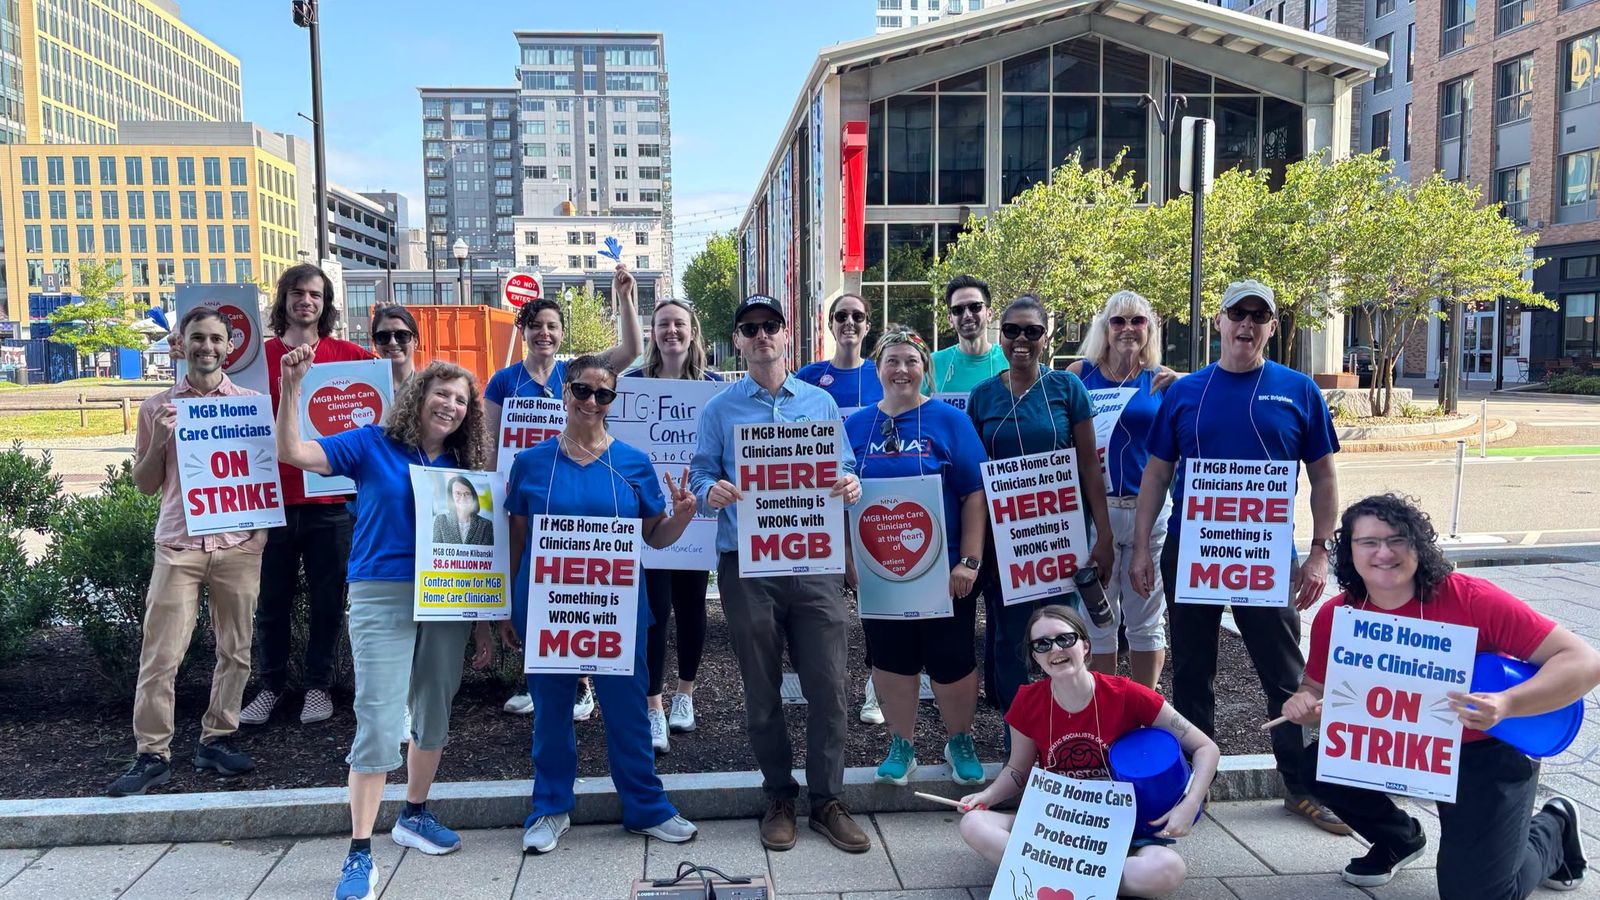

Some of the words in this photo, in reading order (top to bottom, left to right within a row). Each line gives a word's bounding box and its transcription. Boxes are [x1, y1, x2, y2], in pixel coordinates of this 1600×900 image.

[524, 281, 536, 289] NOT
[313, 395, 332, 404] MGB
[334, 393, 356, 401] Home
[327, 401, 363, 411] Clinicians
[508, 400, 514, 409] If
[516, 400, 535, 409] MGB
[536, 399, 561, 411] Home
[189, 404, 218, 419] MGB
[220, 404, 257, 417] Home
[352, 410, 373, 419] heart
[658, 395, 697, 421] Fair
[343, 421, 352, 429] of
[507, 412, 547, 424] Clinicians
[549, 415, 563, 425] Are
[179, 428, 209, 441] Care
[211, 424, 271, 440] Clinicians
[741, 428, 749, 441] If
[751, 426, 775, 440] MGB
[777, 426, 809, 439] Home
[811, 424, 834, 437] Care
[742, 444, 793, 459] Clinicians
[795, 443, 813, 456] Are
[815, 442, 834, 455] Out
[210, 449, 250, 479] ON
[987, 463, 995, 476] If
[997, 459, 1019, 476] MGB
[1020, 456, 1049, 471] Home
[1050, 453, 1071, 465] Care
[1192, 461, 1201, 474] If
[1203, 462, 1227, 474] MGB
[1229, 462, 1261, 475] Home
[1264, 463, 1289, 476] Care
[740, 461, 838, 491] HERE
[991, 476, 1037, 493] Clinicians
[1039, 474, 1055, 485] Are
[1056, 469, 1073, 482] Out
[1192, 478, 1243, 491] Clinicians
[1245, 480, 1265, 491] Are
[1267, 480, 1287, 492] Out
[187, 482, 279, 516] STRIKE
[756, 495, 814, 510] Something
[816, 495, 825, 507] is
[992, 486, 1079, 524] HERE
[863, 514, 881, 522] MGB
[882, 513, 905, 521] Home
[906, 511, 924, 519] Care
[1186, 496, 1289, 523] HERE
[540, 518, 549, 531] If
[550, 518, 574, 532] MGB
[577, 519, 609, 533] Home
[611, 520, 635, 534] Care
[757, 515, 798, 528] WRONG
[800, 513, 825, 527] with
[876, 522, 912, 531] Clinicians
[887, 534, 900, 542] the
[901, 531, 922, 540] heart
[1010, 521, 1060, 540] Something
[1062, 519, 1070, 531] is
[1200, 527, 1260, 542] Something
[1263, 529, 1272, 541] is
[432, 548, 444, 557] MGB
[445, 548, 455, 557] CEO
[456, 549, 469, 557] Anne
[539, 537, 591, 551] Clinicians
[593, 539, 611, 551] Are
[614, 540, 634, 552] Out
[751, 532, 832, 562] MGB
[892, 543, 901, 551] of
[1013, 541, 1048, 558] WRONG
[1050, 537, 1070, 551] with
[1200, 545, 1242, 558] WRONG
[1244, 547, 1270, 559] with
[433, 559, 449, 570] $8.6
[450, 560, 478, 570] MILLION
[479, 561, 492, 570] PAY
[882, 558, 905, 567] patient
[534, 556, 635, 586] HERE
[1009, 553, 1079, 589] MGB
[1189, 562, 1275, 591] MGB
[424, 576, 453, 587] Contract
[456, 579, 471, 588] now
[473, 578, 483, 588] for
[485, 578, 501, 588] MGB
[423, 592, 444, 602] Home
[446, 592, 462, 603] Care
[464, 592, 502, 603] Clinicians!
[548, 591, 608, 607] Something
[610, 593, 619, 605] is
[549, 610, 590, 624] WRONG
[592, 612, 617, 625] with
[538, 629, 622, 658] MGB
[1353, 619, 1393, 642] MGB
[1397, 626, 1452, 653] Home
[1333, 646, 1373, 669] Care
[1377, 653, 1466, 684] Clinicians
[1366, 686, 1422, 723] ON
[1062, 732, 1095, 741] SOCIALISTS
[1325, 721, 1454, 775] STRIKE
[1031, 774, 1063, 795] MGB
[1063, 785, 1102, 804] Home
[1105, 790, 1133, 807] Care
[1045, 803, 1110, 829] Clinicians
[1033, 822, 1108, 855] Protecting
[1021, 842, 1074, 872] Patient
[1075, 859, 1107, 878] Care
